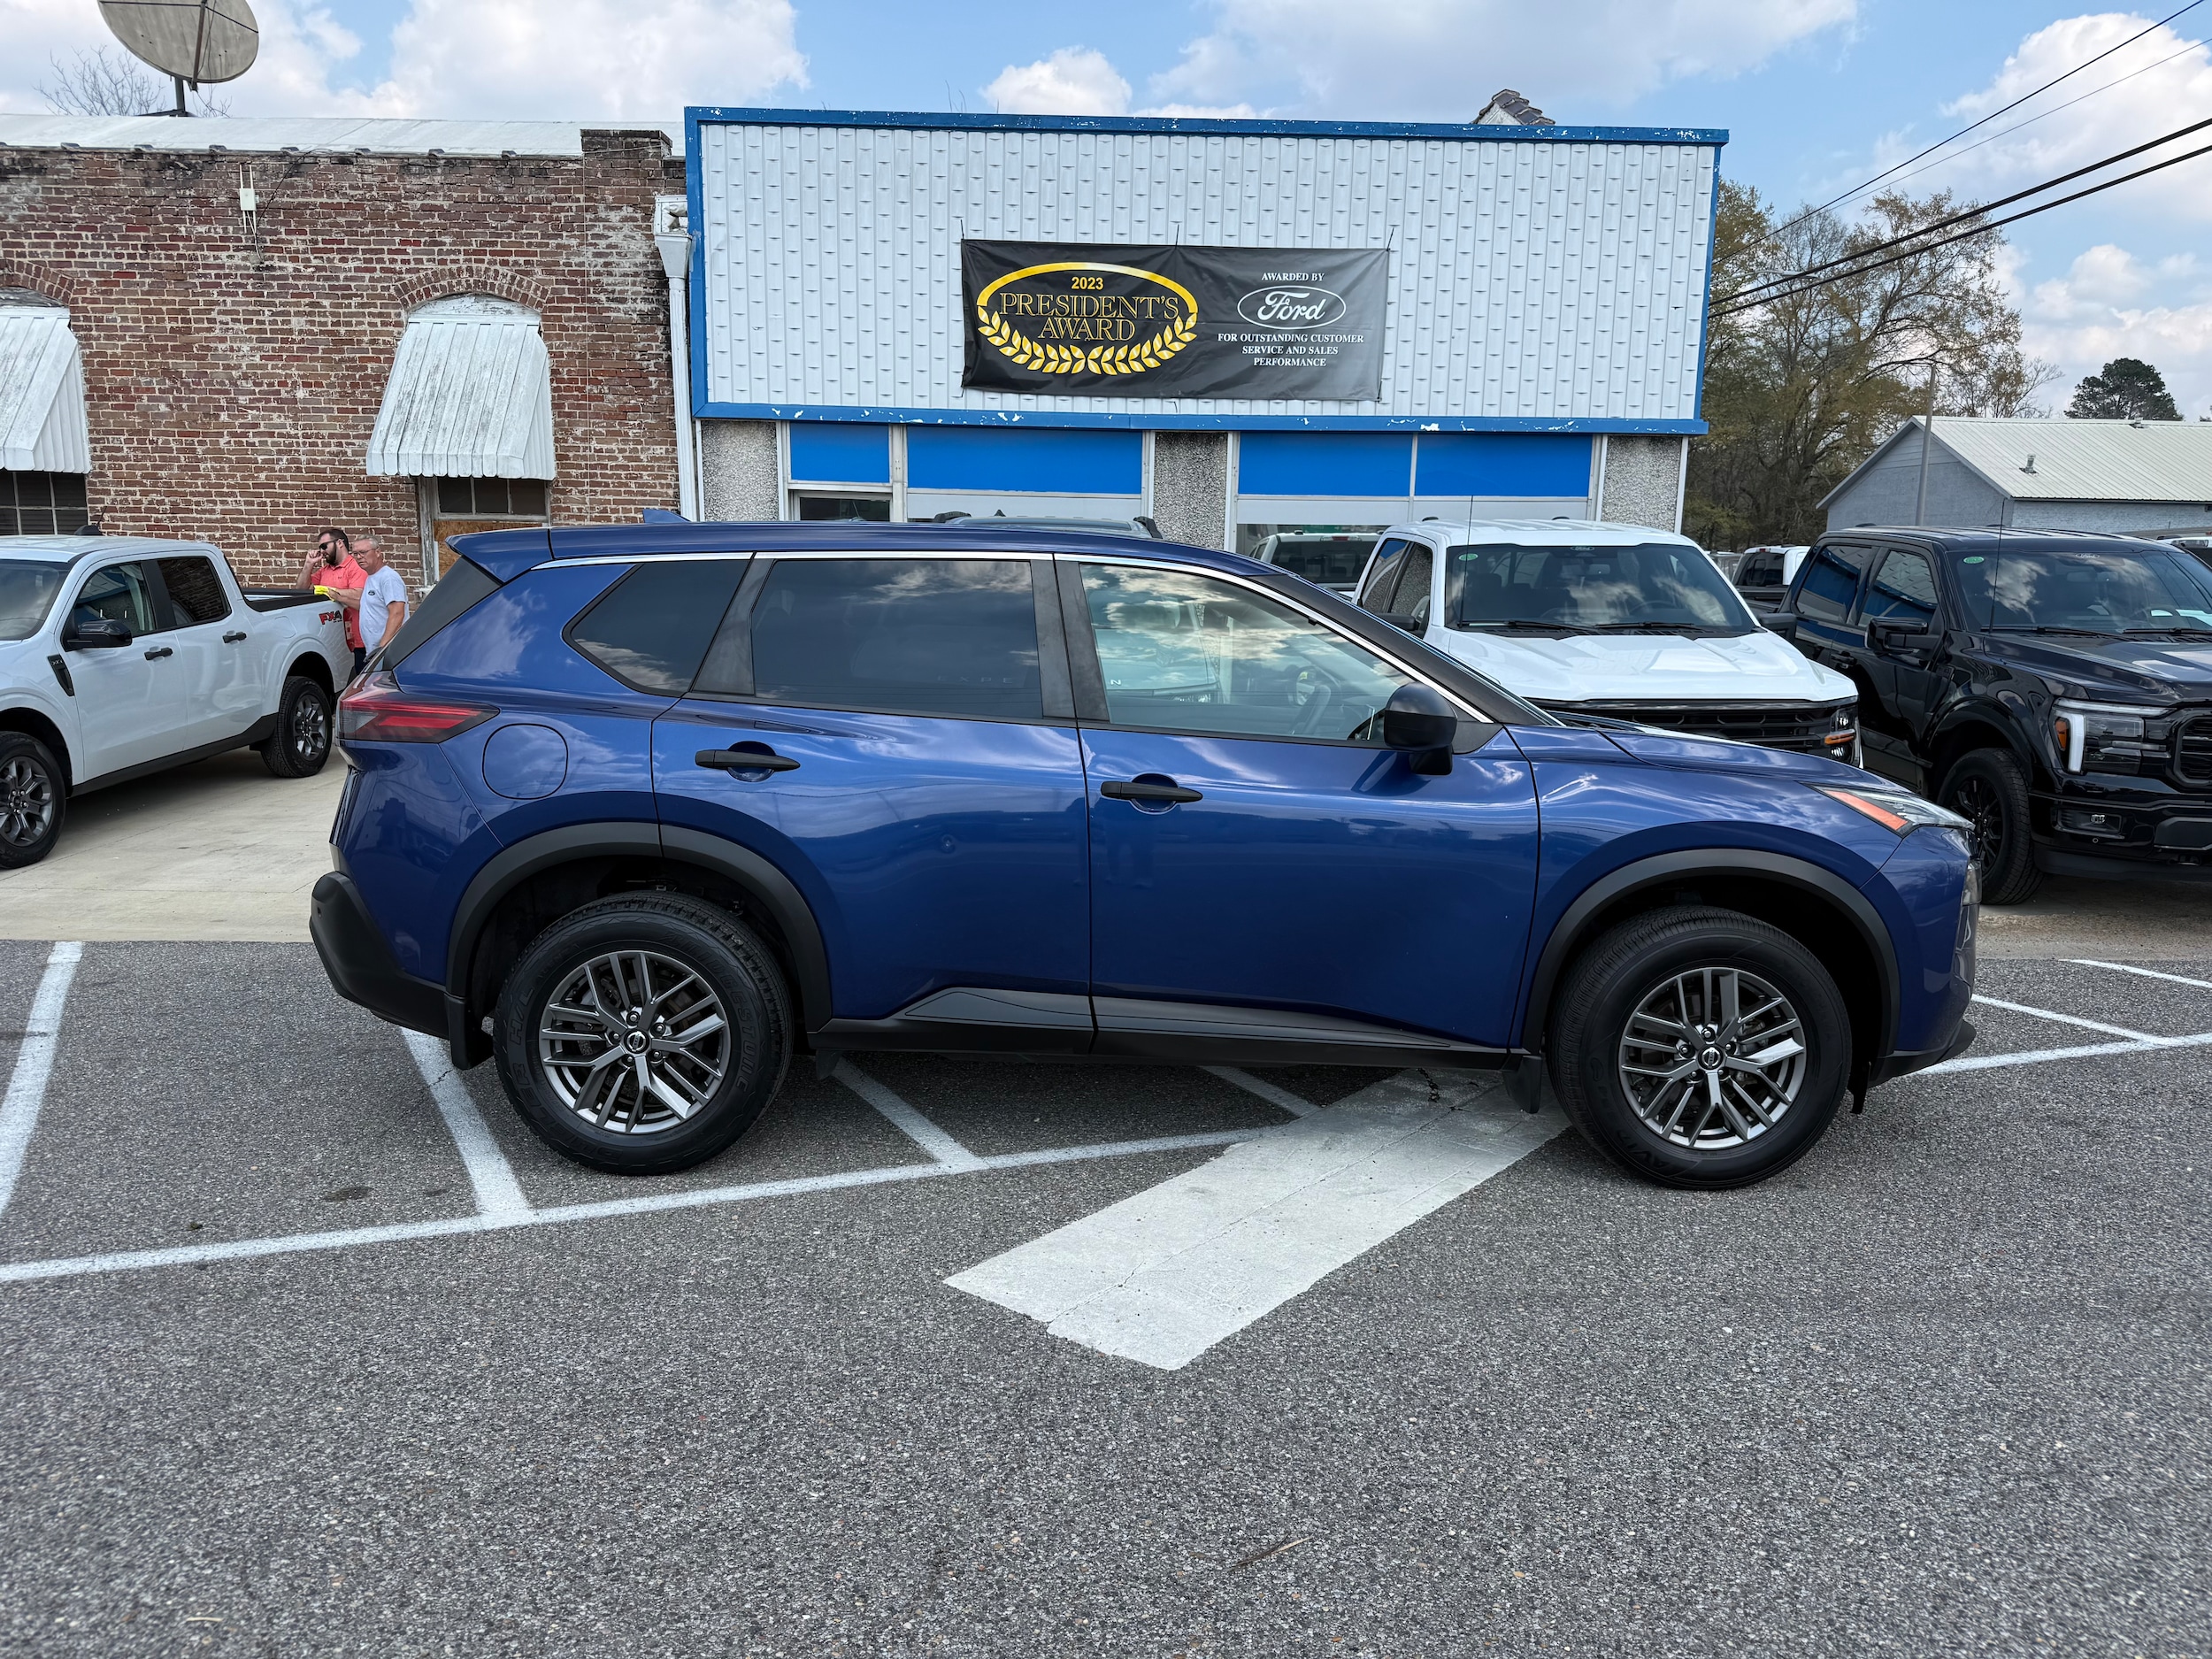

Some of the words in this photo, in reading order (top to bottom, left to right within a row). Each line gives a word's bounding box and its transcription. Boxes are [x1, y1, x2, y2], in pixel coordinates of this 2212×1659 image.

[1071, 277, 1104, 290] 2023
[1261, 273, 1309, 281] AWARDED
[1311, 273, 1325, 281] BY
[999, 293, 1179, 319] PRESIDENT'S
[1257, 291, 1326, 320] Ford
[1037, 317, 1136, 342] AWARD
[1217, 333, 1238, 342] FOR
[1240, 333, 1308, 343] OUTSTANDING
[1310, 334, 1363, 343] CUSTOMER
[1242, 345, 1283, 355] SERVICE
[1286, 346, 1306, 355] AND
[1309, 346, 1339, 355] SALES
[1254, 357, 1326, 367] PERFORMANCE
[319, 611, 342, 625] FX4
[510, 987, 534, 1046] H/L
[657, 930, 757, 1092] BRIDGESTONE
